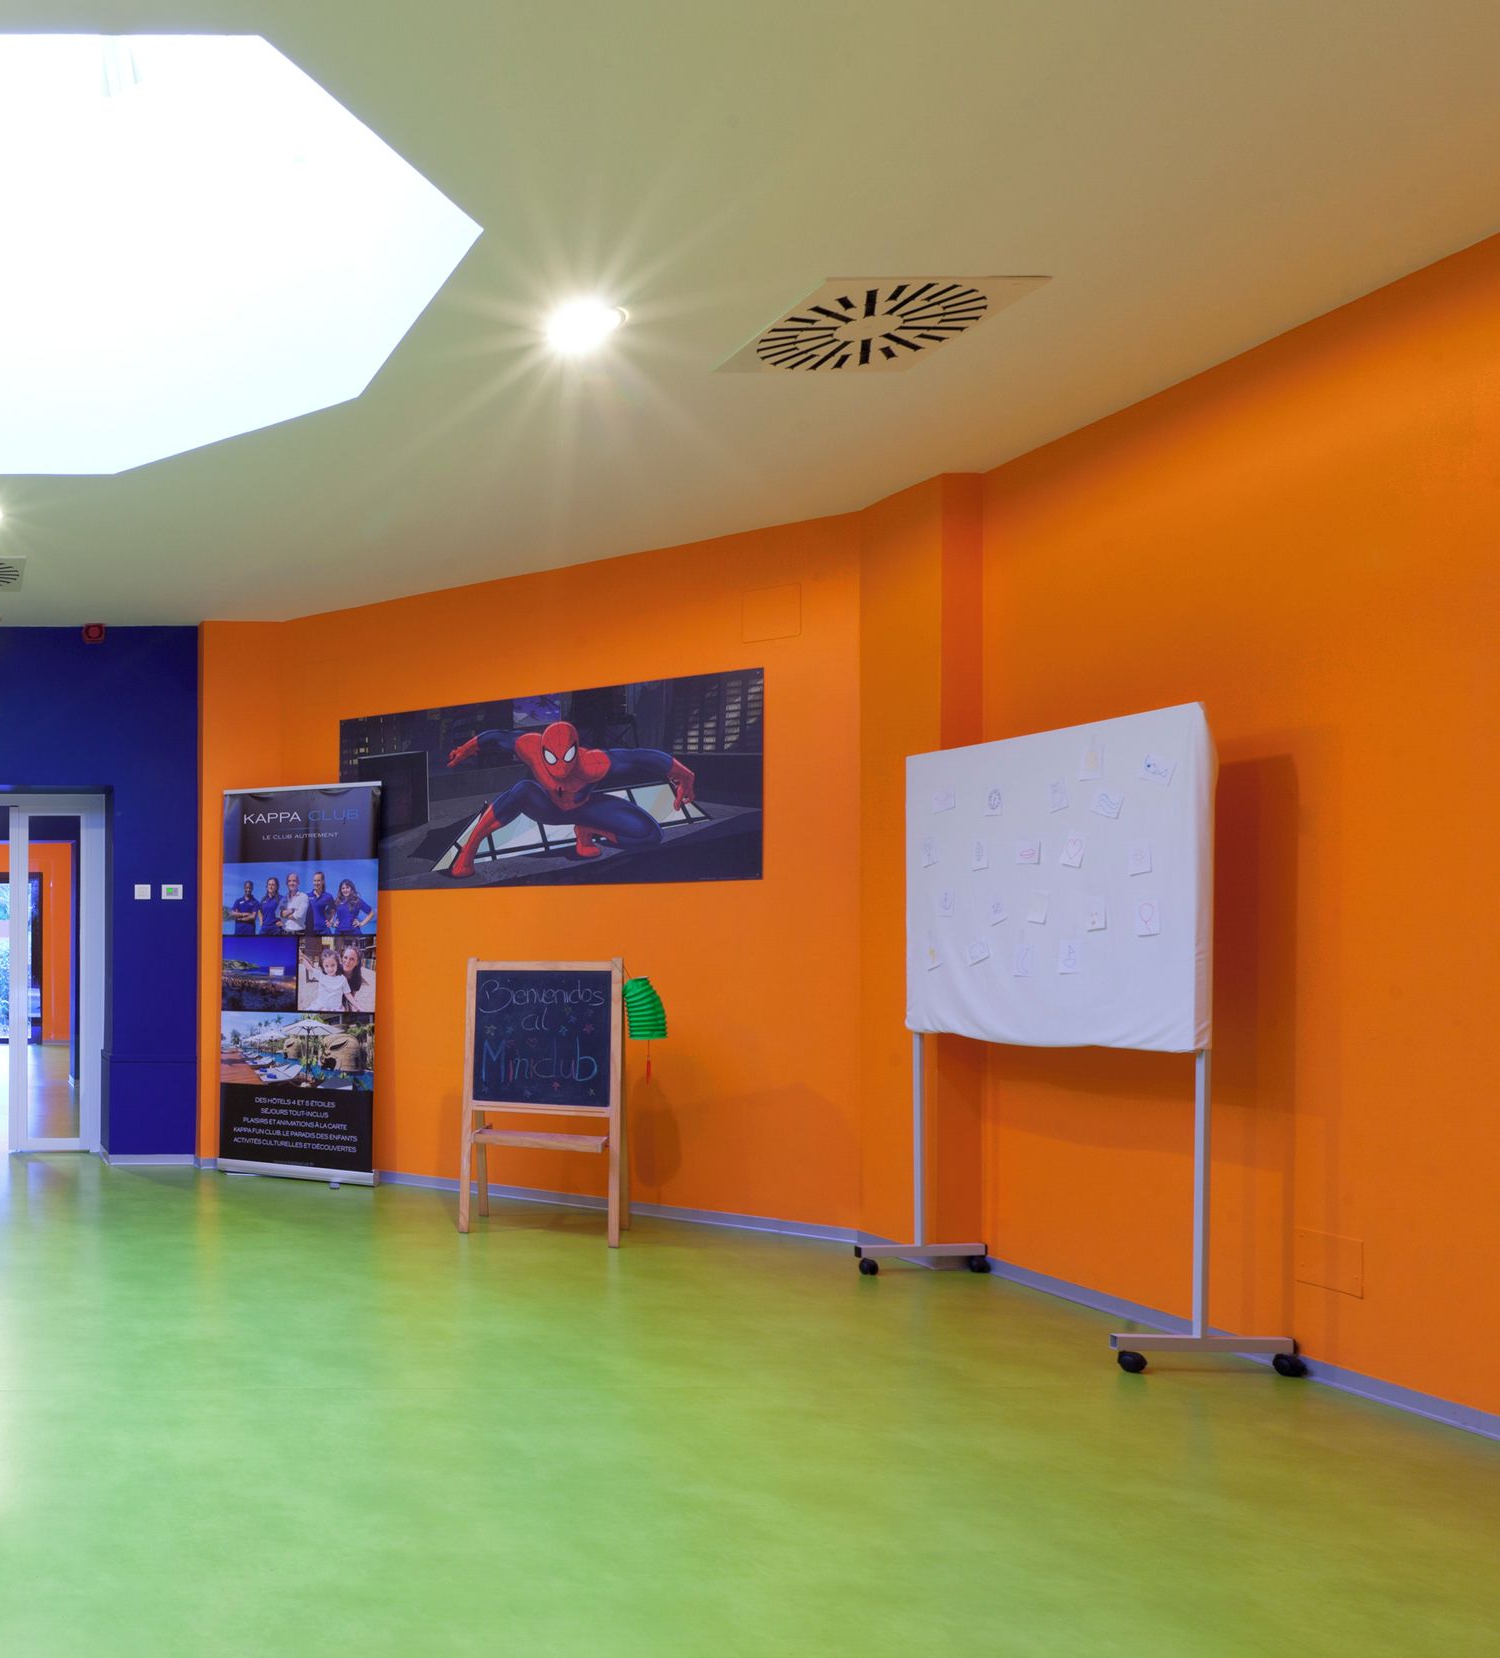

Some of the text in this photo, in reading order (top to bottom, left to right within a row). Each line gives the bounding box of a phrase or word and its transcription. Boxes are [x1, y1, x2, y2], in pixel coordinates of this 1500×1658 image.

[243, 808, 360, 825] KAPPA CLUB
[294, 832, 339, 840] AUTREMENT
[478, 979, 605, 1014] Bienvenidos
[521, 1008, 548, 1031] al
[482, 1036, 598, 1083] Miniclub
[260, 1107, 289, 1116] SÉJOURS
[243, 1116, 269, 1125] PLAISIRS
[277, 1119, 314, 1128] ANIMATIONS
[328, 1123, 347, 1131] CARTE
[262, 1139, 303, 1149] CULTURELLES
[290, 1131, 316, 1139] PARADIS
[316, 1132, 329, 1140] DES
[329, 1134, 358, 1142] ENFANTS
